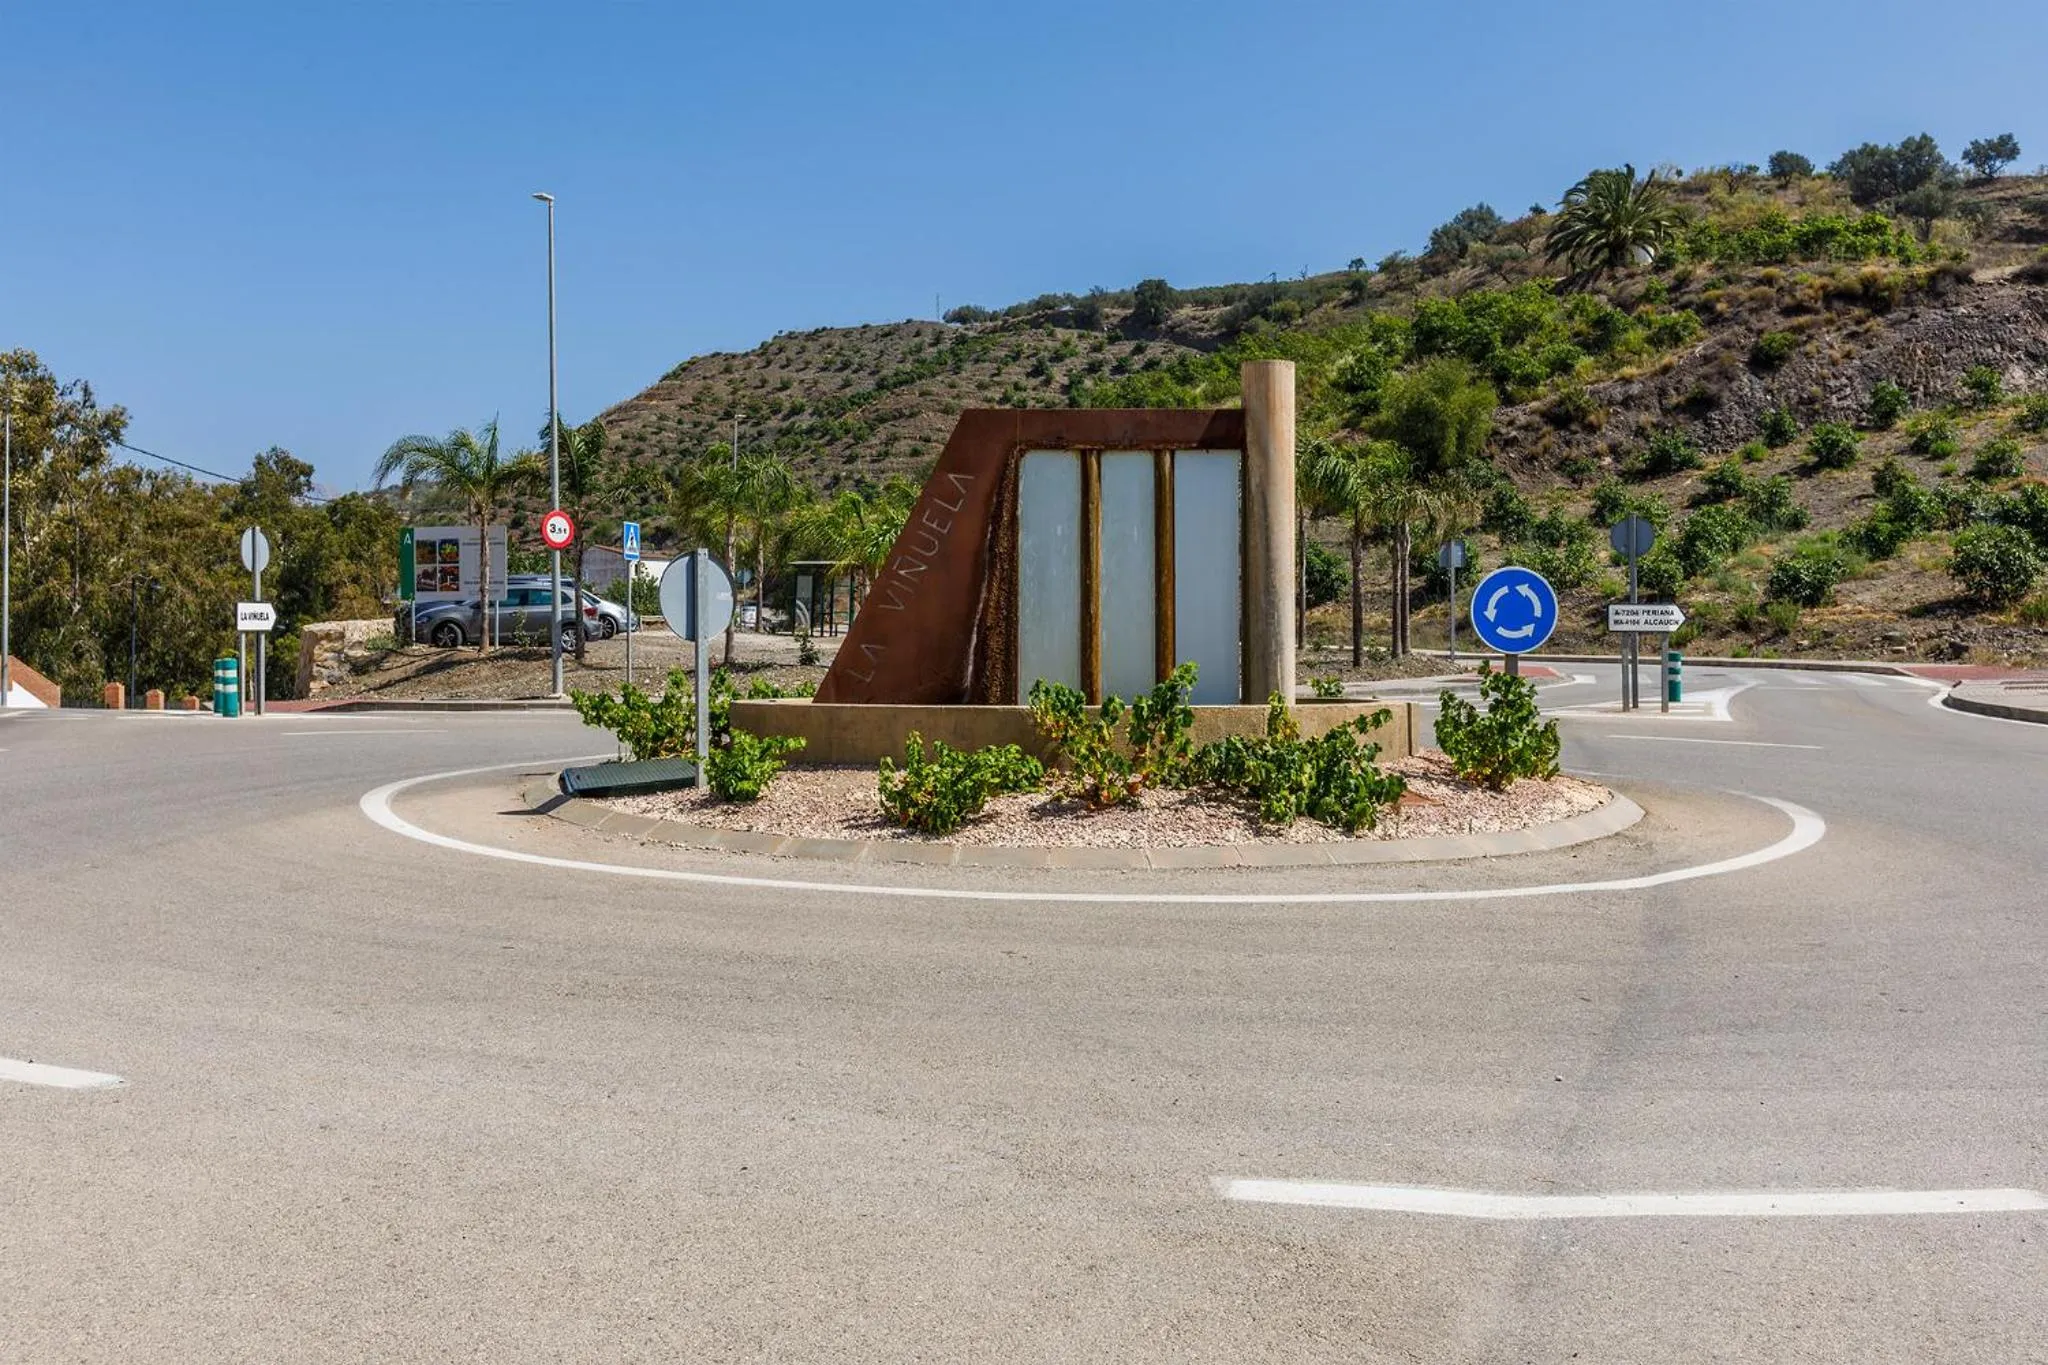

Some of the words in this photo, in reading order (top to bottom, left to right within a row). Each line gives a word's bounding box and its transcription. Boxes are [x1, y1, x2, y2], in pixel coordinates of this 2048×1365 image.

[240, 612, 248, 621] LA
[846, 643, 887, 683] LA
[878, 472, 975, 611] VIÑUELA
